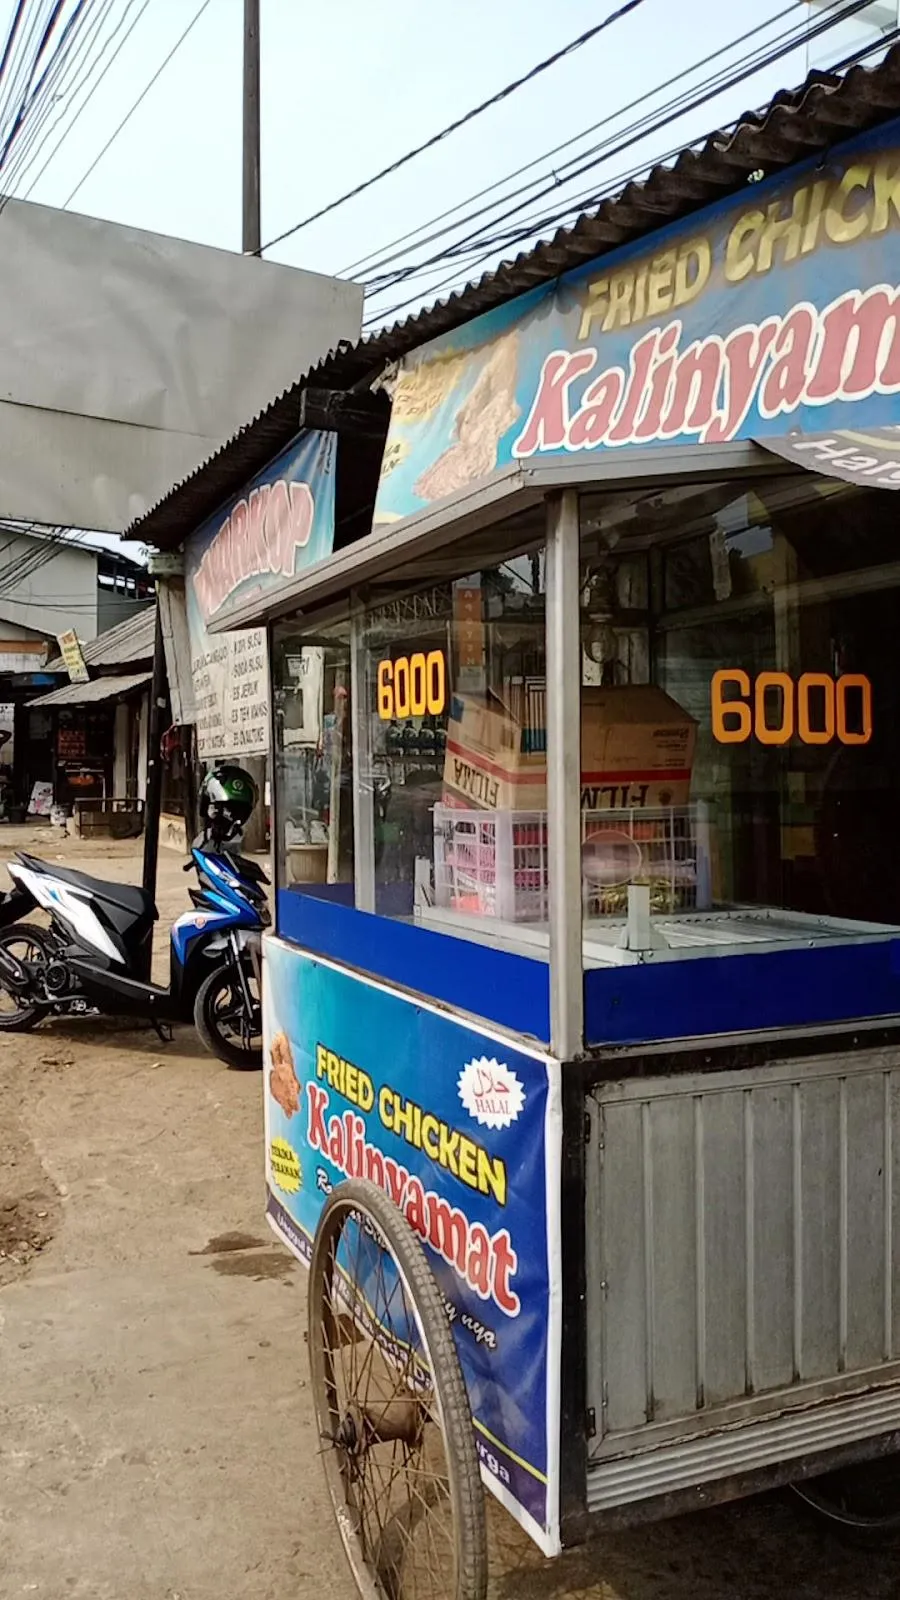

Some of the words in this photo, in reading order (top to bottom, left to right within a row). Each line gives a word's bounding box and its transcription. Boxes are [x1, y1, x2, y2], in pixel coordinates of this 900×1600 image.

[577, 239, 713, 340] FRIED
[377, 649, 446, 720] 6000
[711, 669, 873, 745] 6000
[454, 758, 500, 809] FILMA
[315, 1042, 374, 1114] FRIED
[379, 1084, 508, 1206] CHICKEN
[475, 1099, 513, 1115] HALAL
